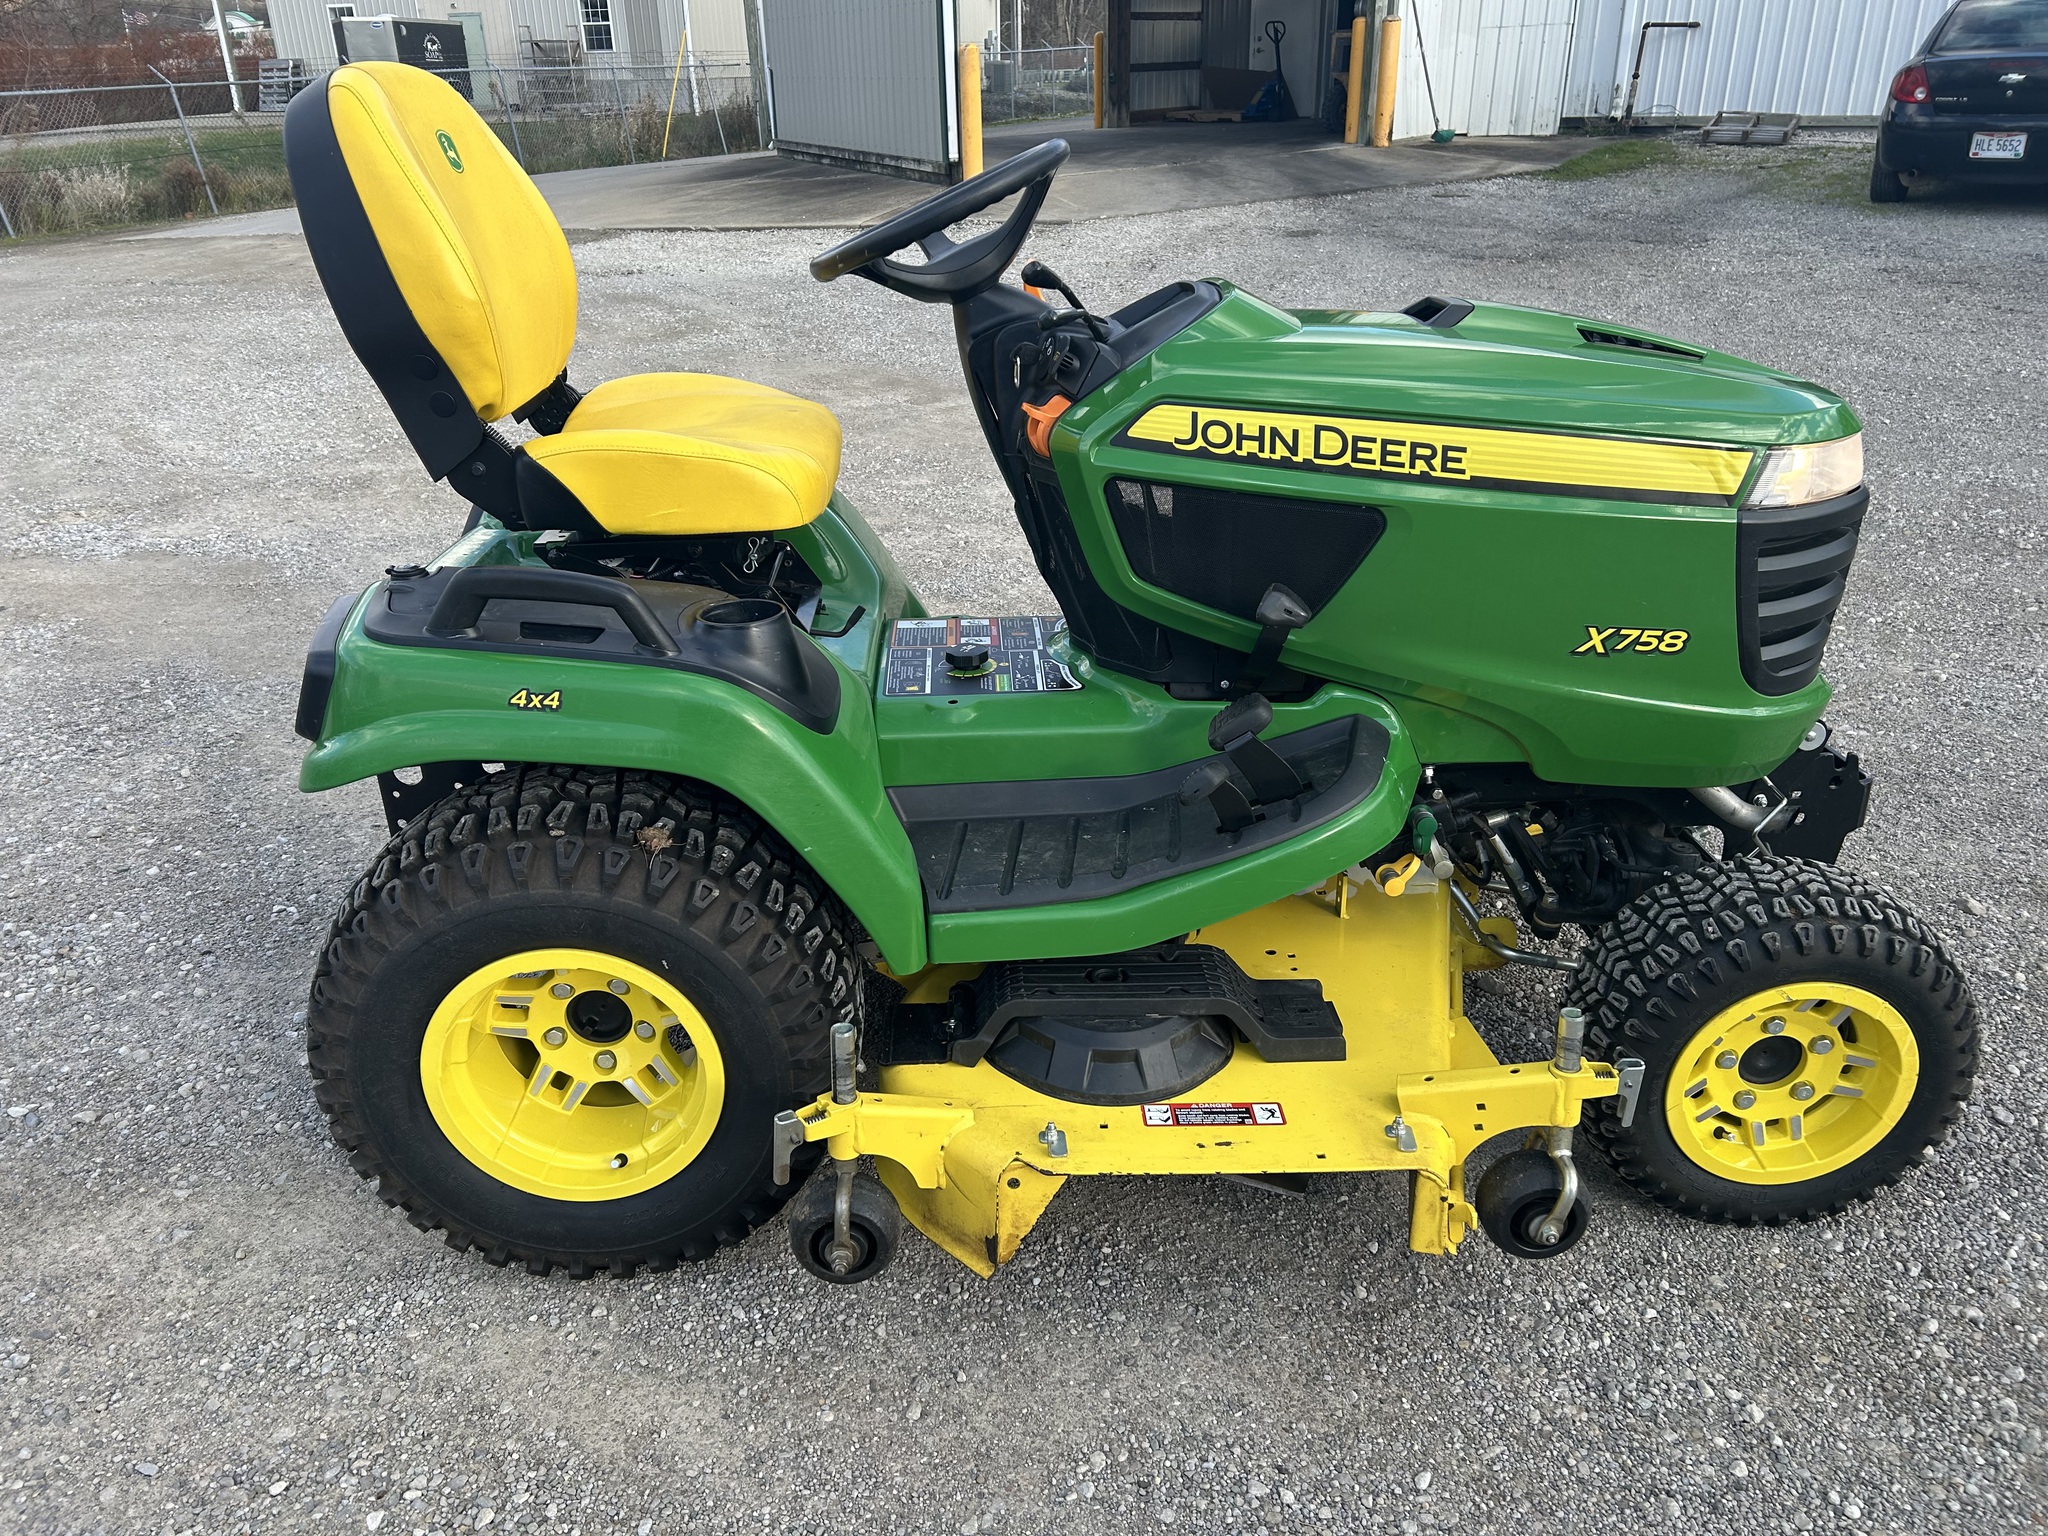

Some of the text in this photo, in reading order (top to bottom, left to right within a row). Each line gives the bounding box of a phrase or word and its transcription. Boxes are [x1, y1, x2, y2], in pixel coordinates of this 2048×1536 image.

[1974, 138, 2022, 152] HLE 5652
[1174, 411, 1468, 475] JOHN DEERE
[1574, 627, 1689, 653] X758
[510, 689, 560, 709] 4x4
